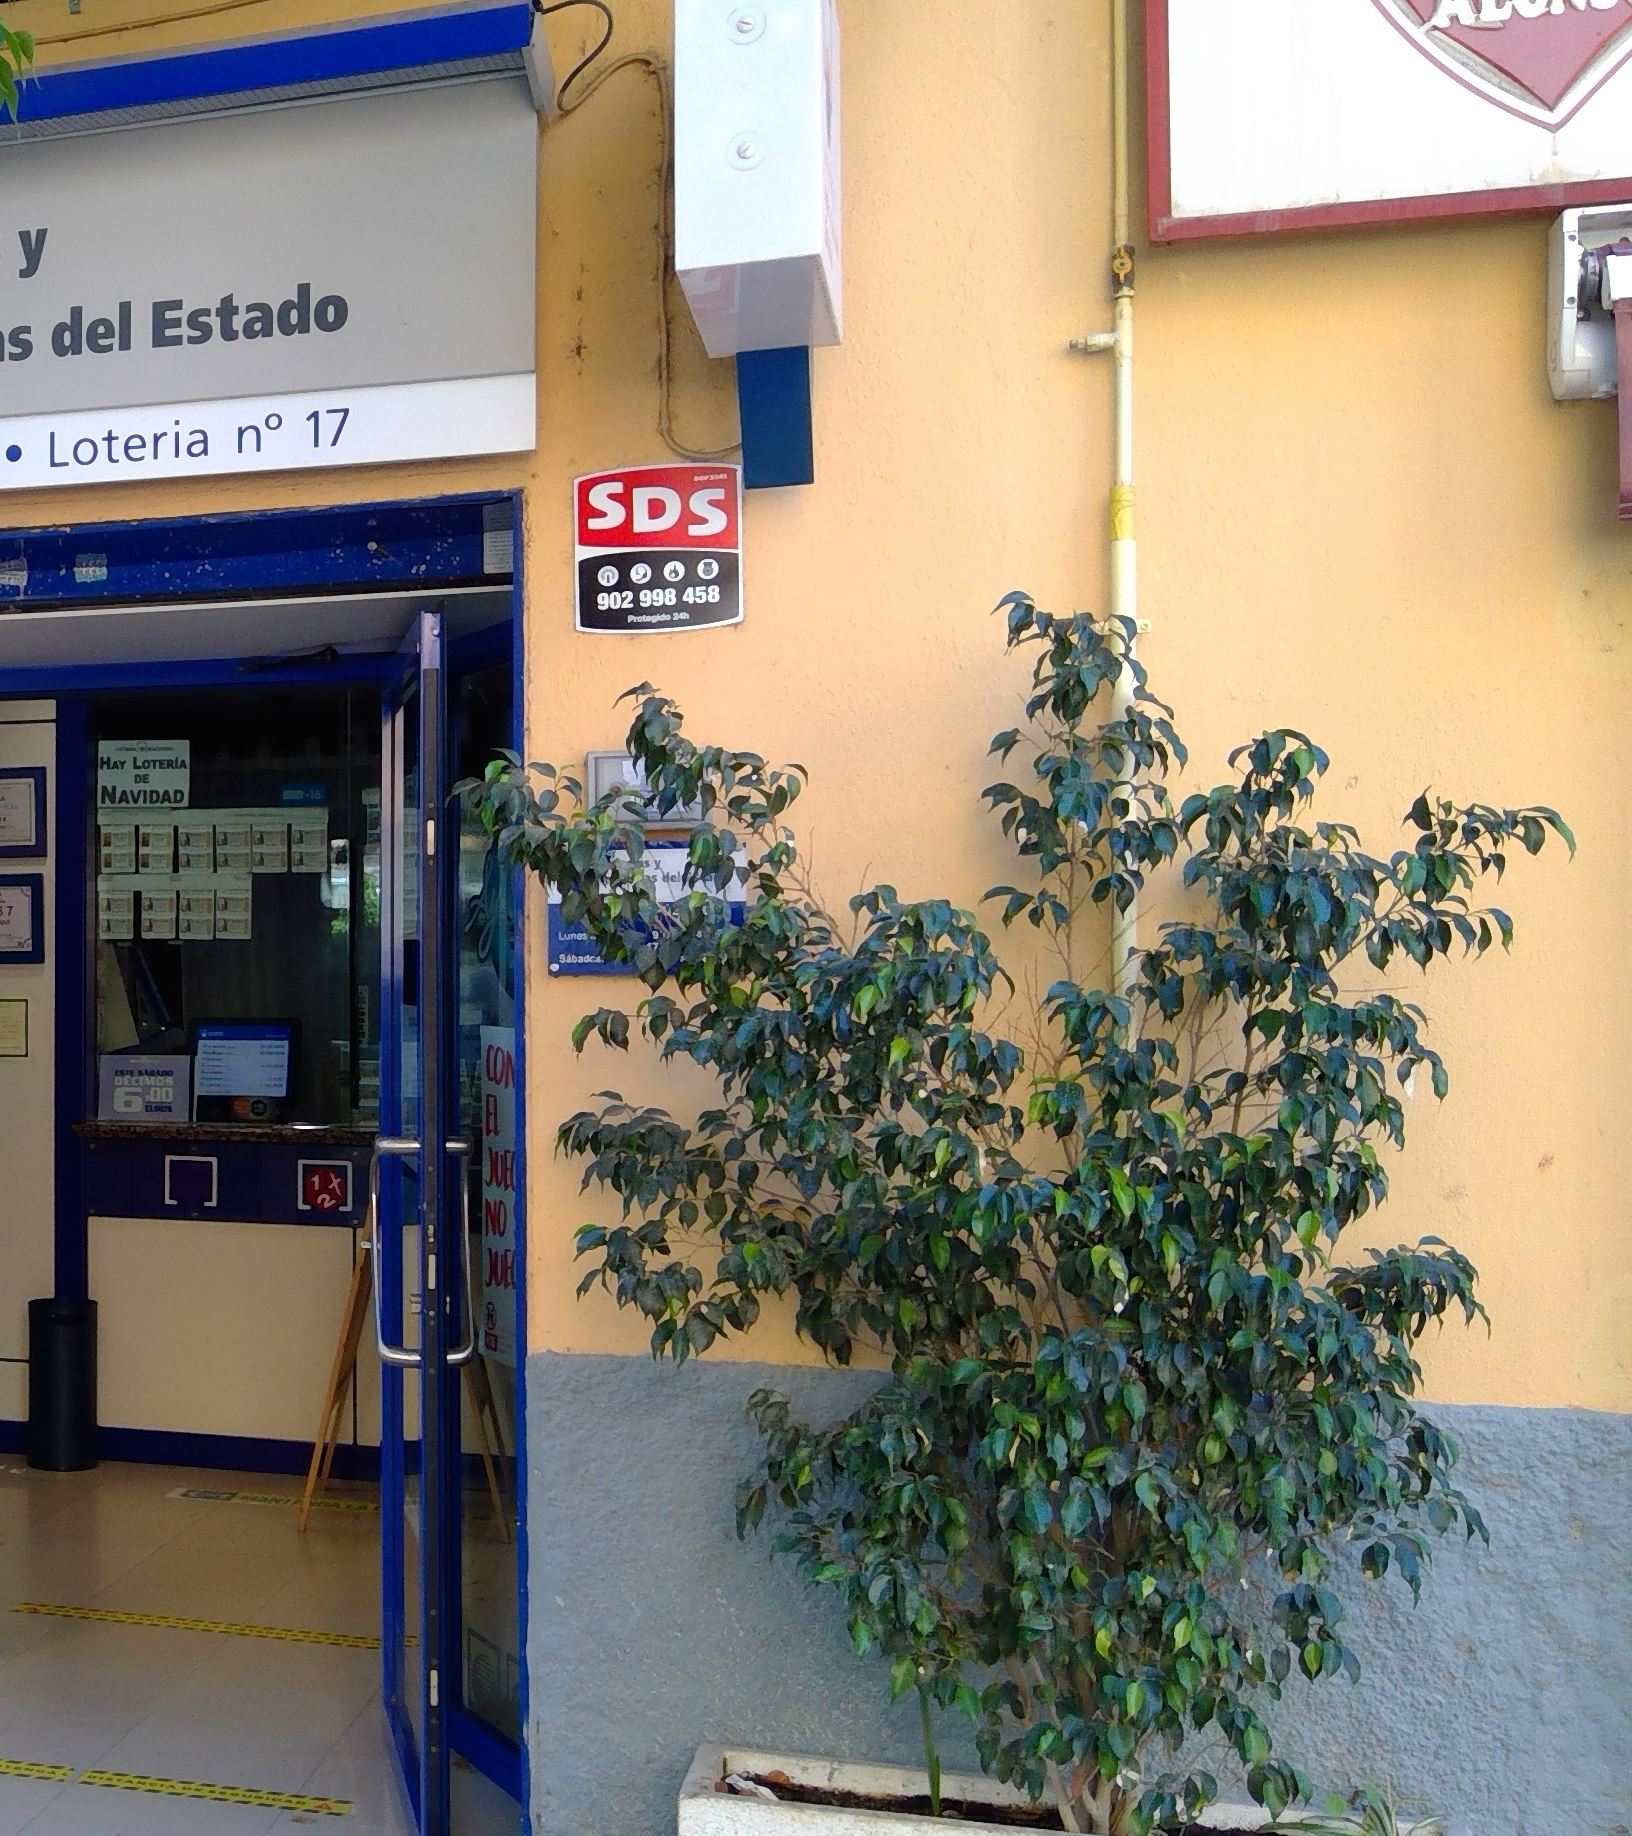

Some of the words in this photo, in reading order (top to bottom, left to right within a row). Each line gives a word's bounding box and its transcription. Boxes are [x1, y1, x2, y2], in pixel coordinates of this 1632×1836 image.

[18, 228, 48, 279] y
[51, 301, 132, 357] del
[151, 283, 349, 348] Estado
[48, 420, 209, 468] Loteria
[305, 408, 351, 449] 17
[587, 481, 728, 537] SDS
[596, 590, 634, 611] 902
[639, 588, 677, 607] 998
[682, 585, 720, 604] 458
[100, 785, 185, 805] NAVIDAD
[134, 773, 150, 784] DE
[485, 1198, 506, 1238] NO
